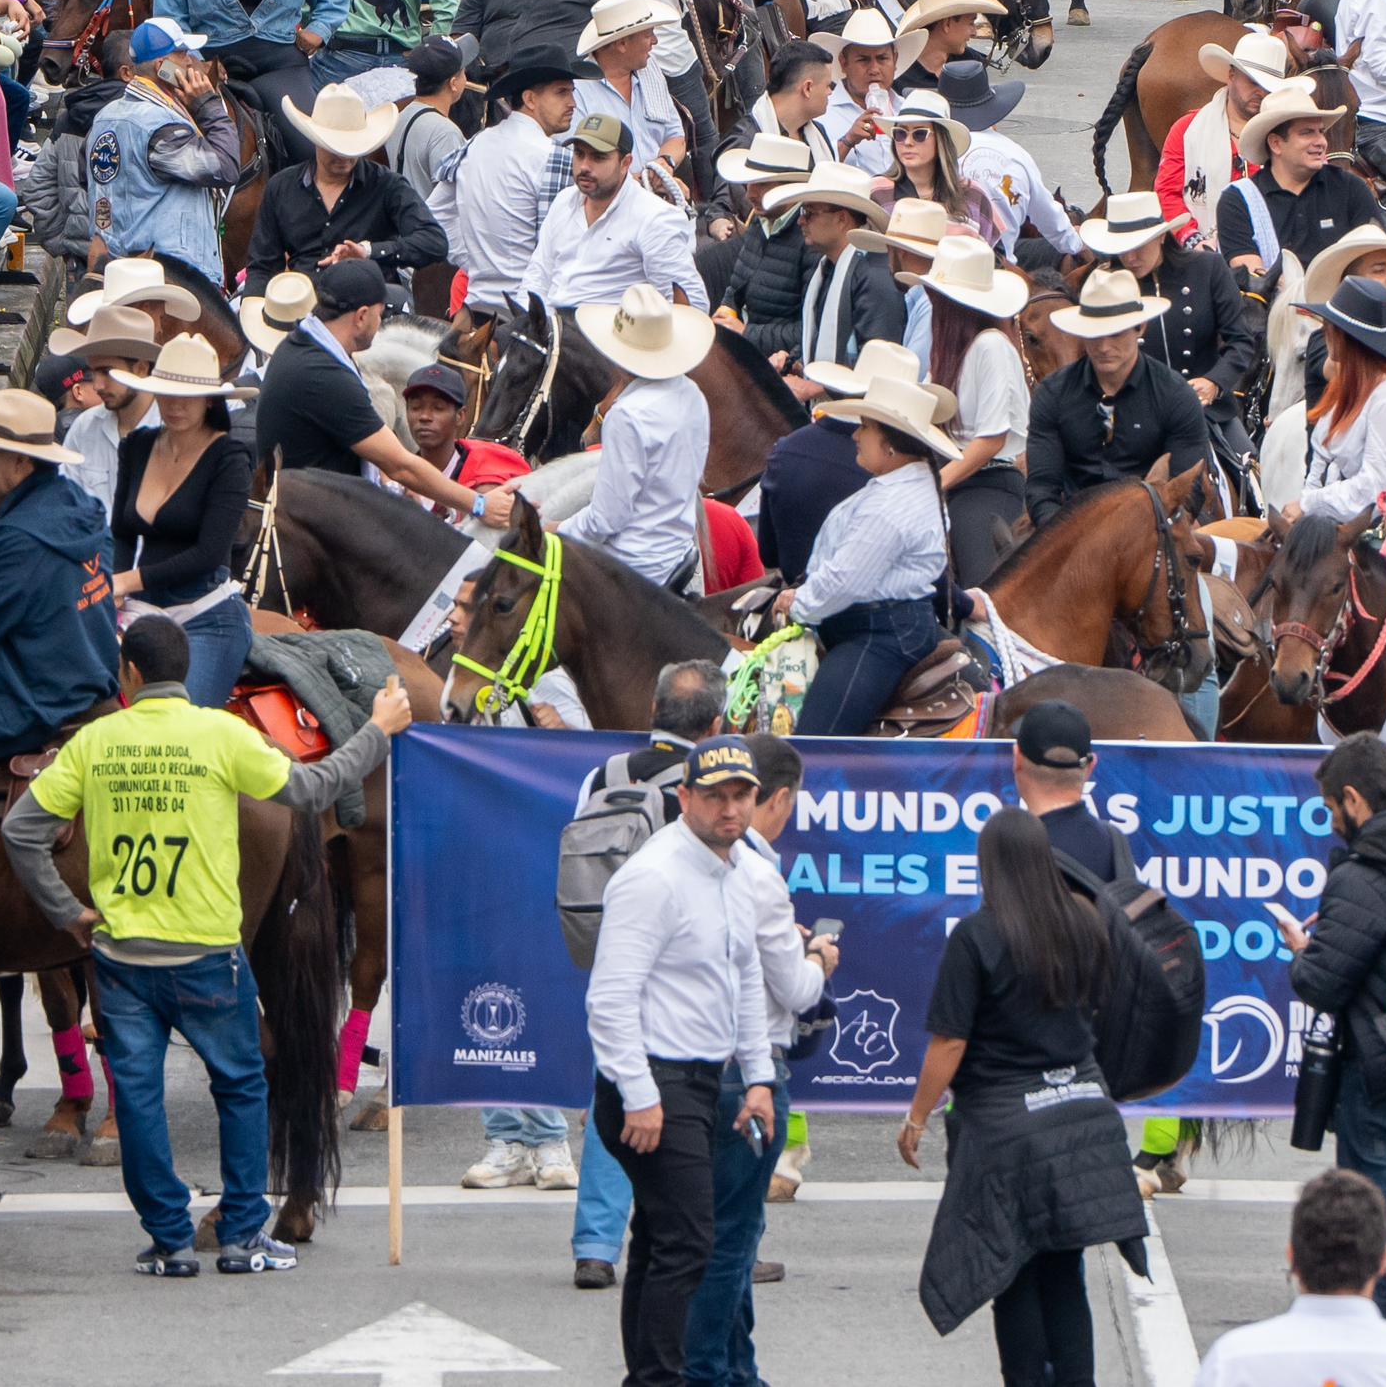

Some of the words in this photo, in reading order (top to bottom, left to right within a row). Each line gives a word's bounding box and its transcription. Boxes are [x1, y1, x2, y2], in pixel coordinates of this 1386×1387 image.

[116, 744, 142, 758] TIENES
[144, 744, 163, 758] UNA
[131, 762, 157, 776] QUEJA
[159, 761, 167, 775] O
[168, 762, 208, 778] RECLAMO
[108, 778, 160, 794] COMUNICATE
[162, 779, 172, 793] AL
[112, 796, 131, 813] 311
[134, 796, 154, 813] 740
[156, 796, 168, 813] 85
[171, 796, 185, 813] 04
[112, 832, 190, 898] 267
[454, 1048, 537, 1064] MANIZALES
[811, 1075, 918, 1085] ASDECALDAS
